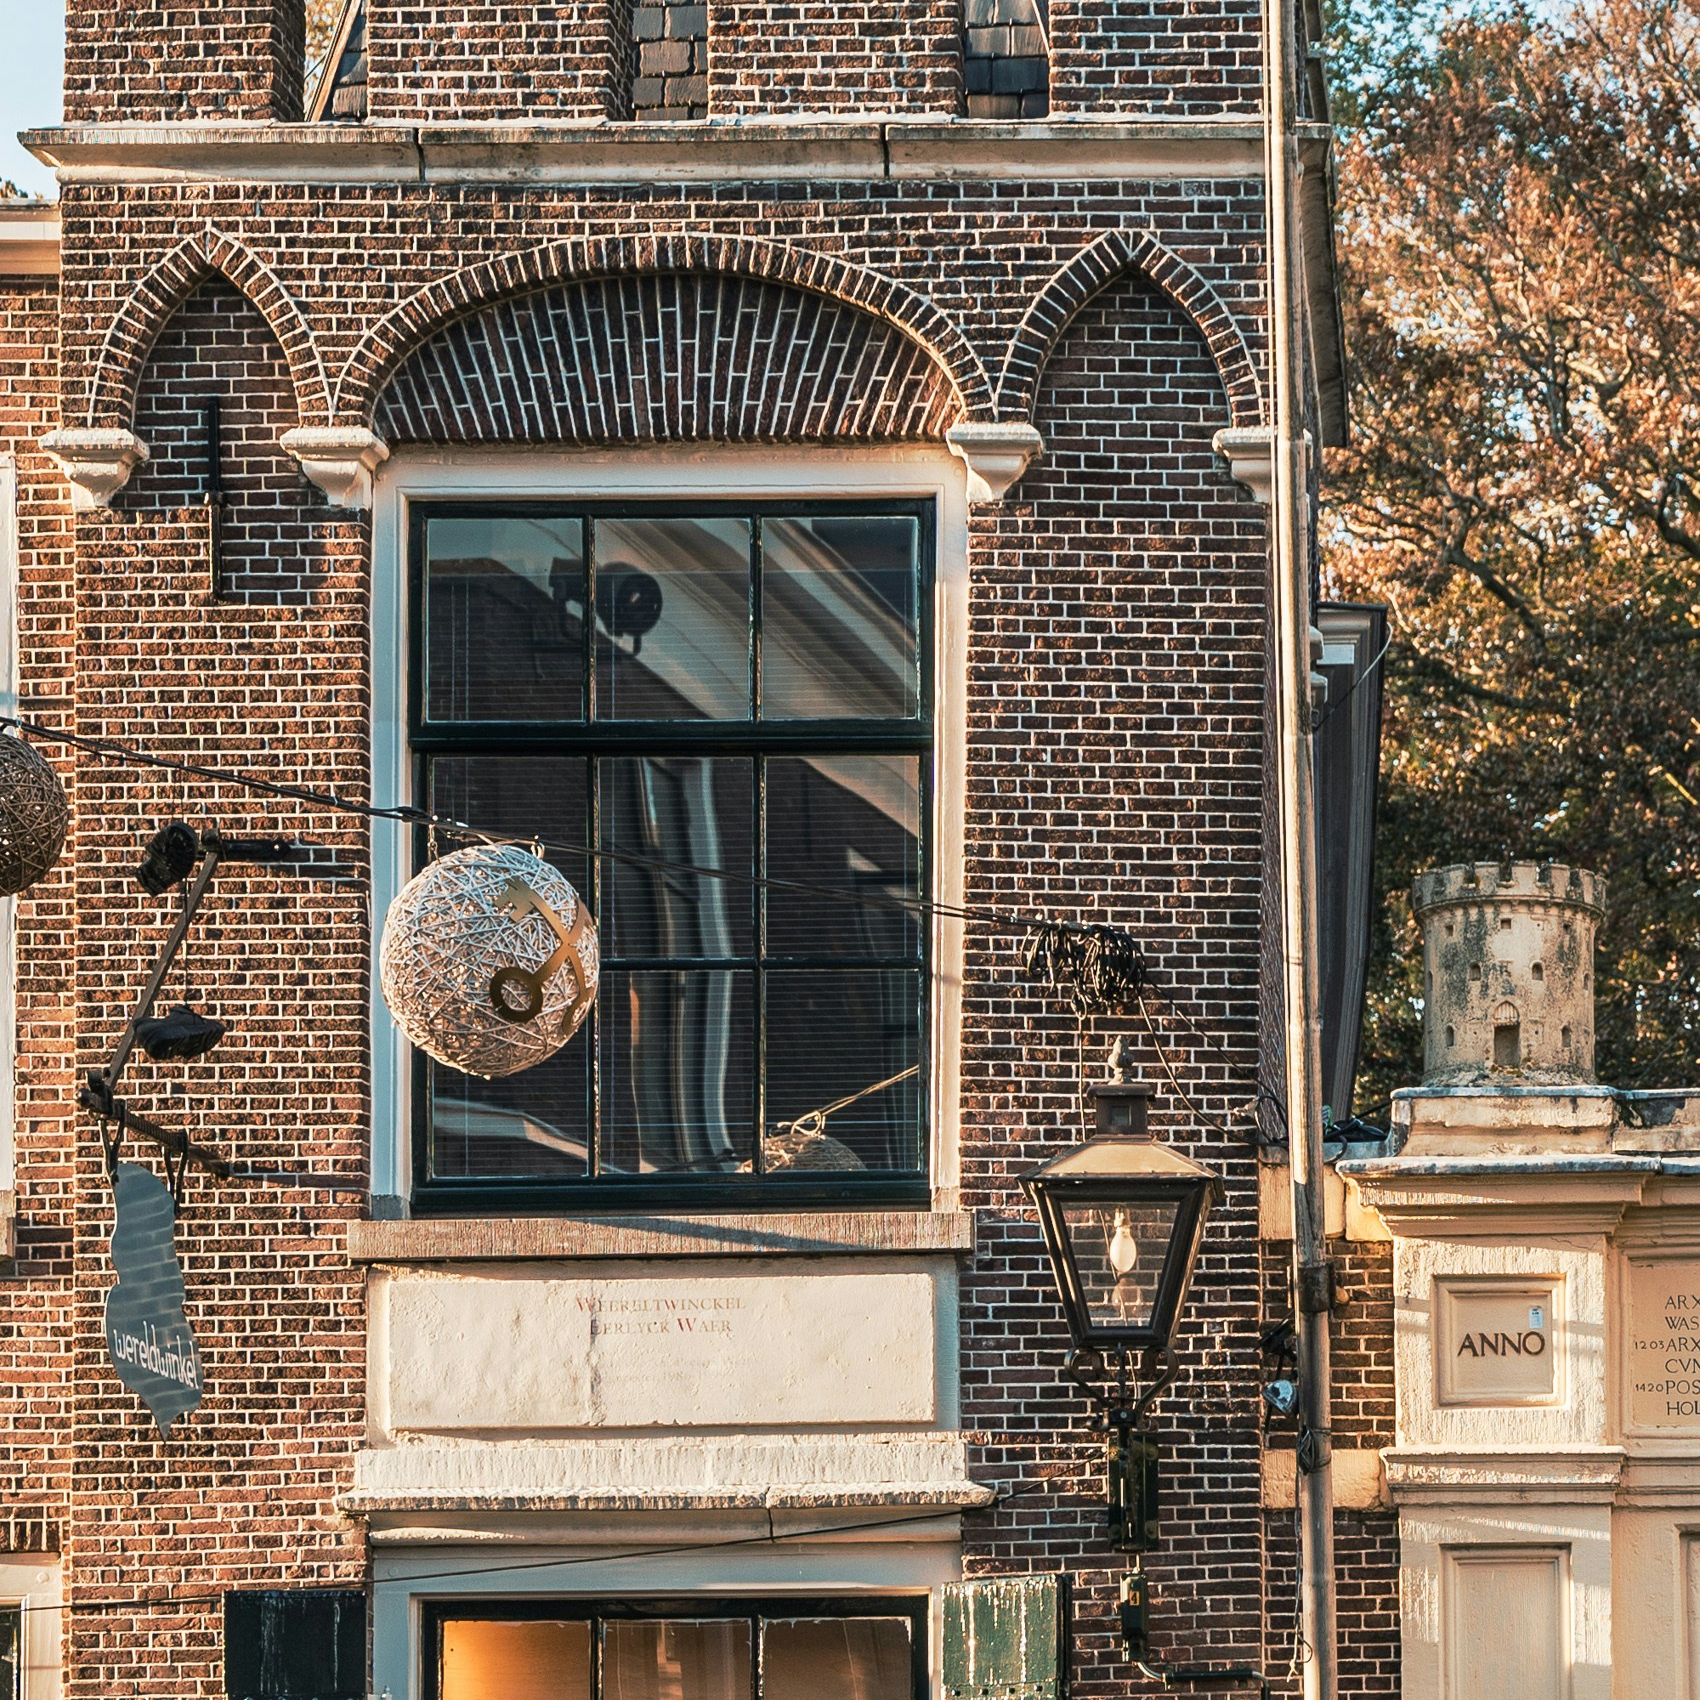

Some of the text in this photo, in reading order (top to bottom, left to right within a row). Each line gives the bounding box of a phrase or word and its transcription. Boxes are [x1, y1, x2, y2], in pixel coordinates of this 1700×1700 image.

[677, 1317, 733, 1333] WAER
[1458, 1331, 1545, 1357] ANNO
[1634, 1340, 1665, 1351] 1203
[112, 1320, 200, 1391] wereldwinkel
[1634, 1383, 1664, 1393] 1420
